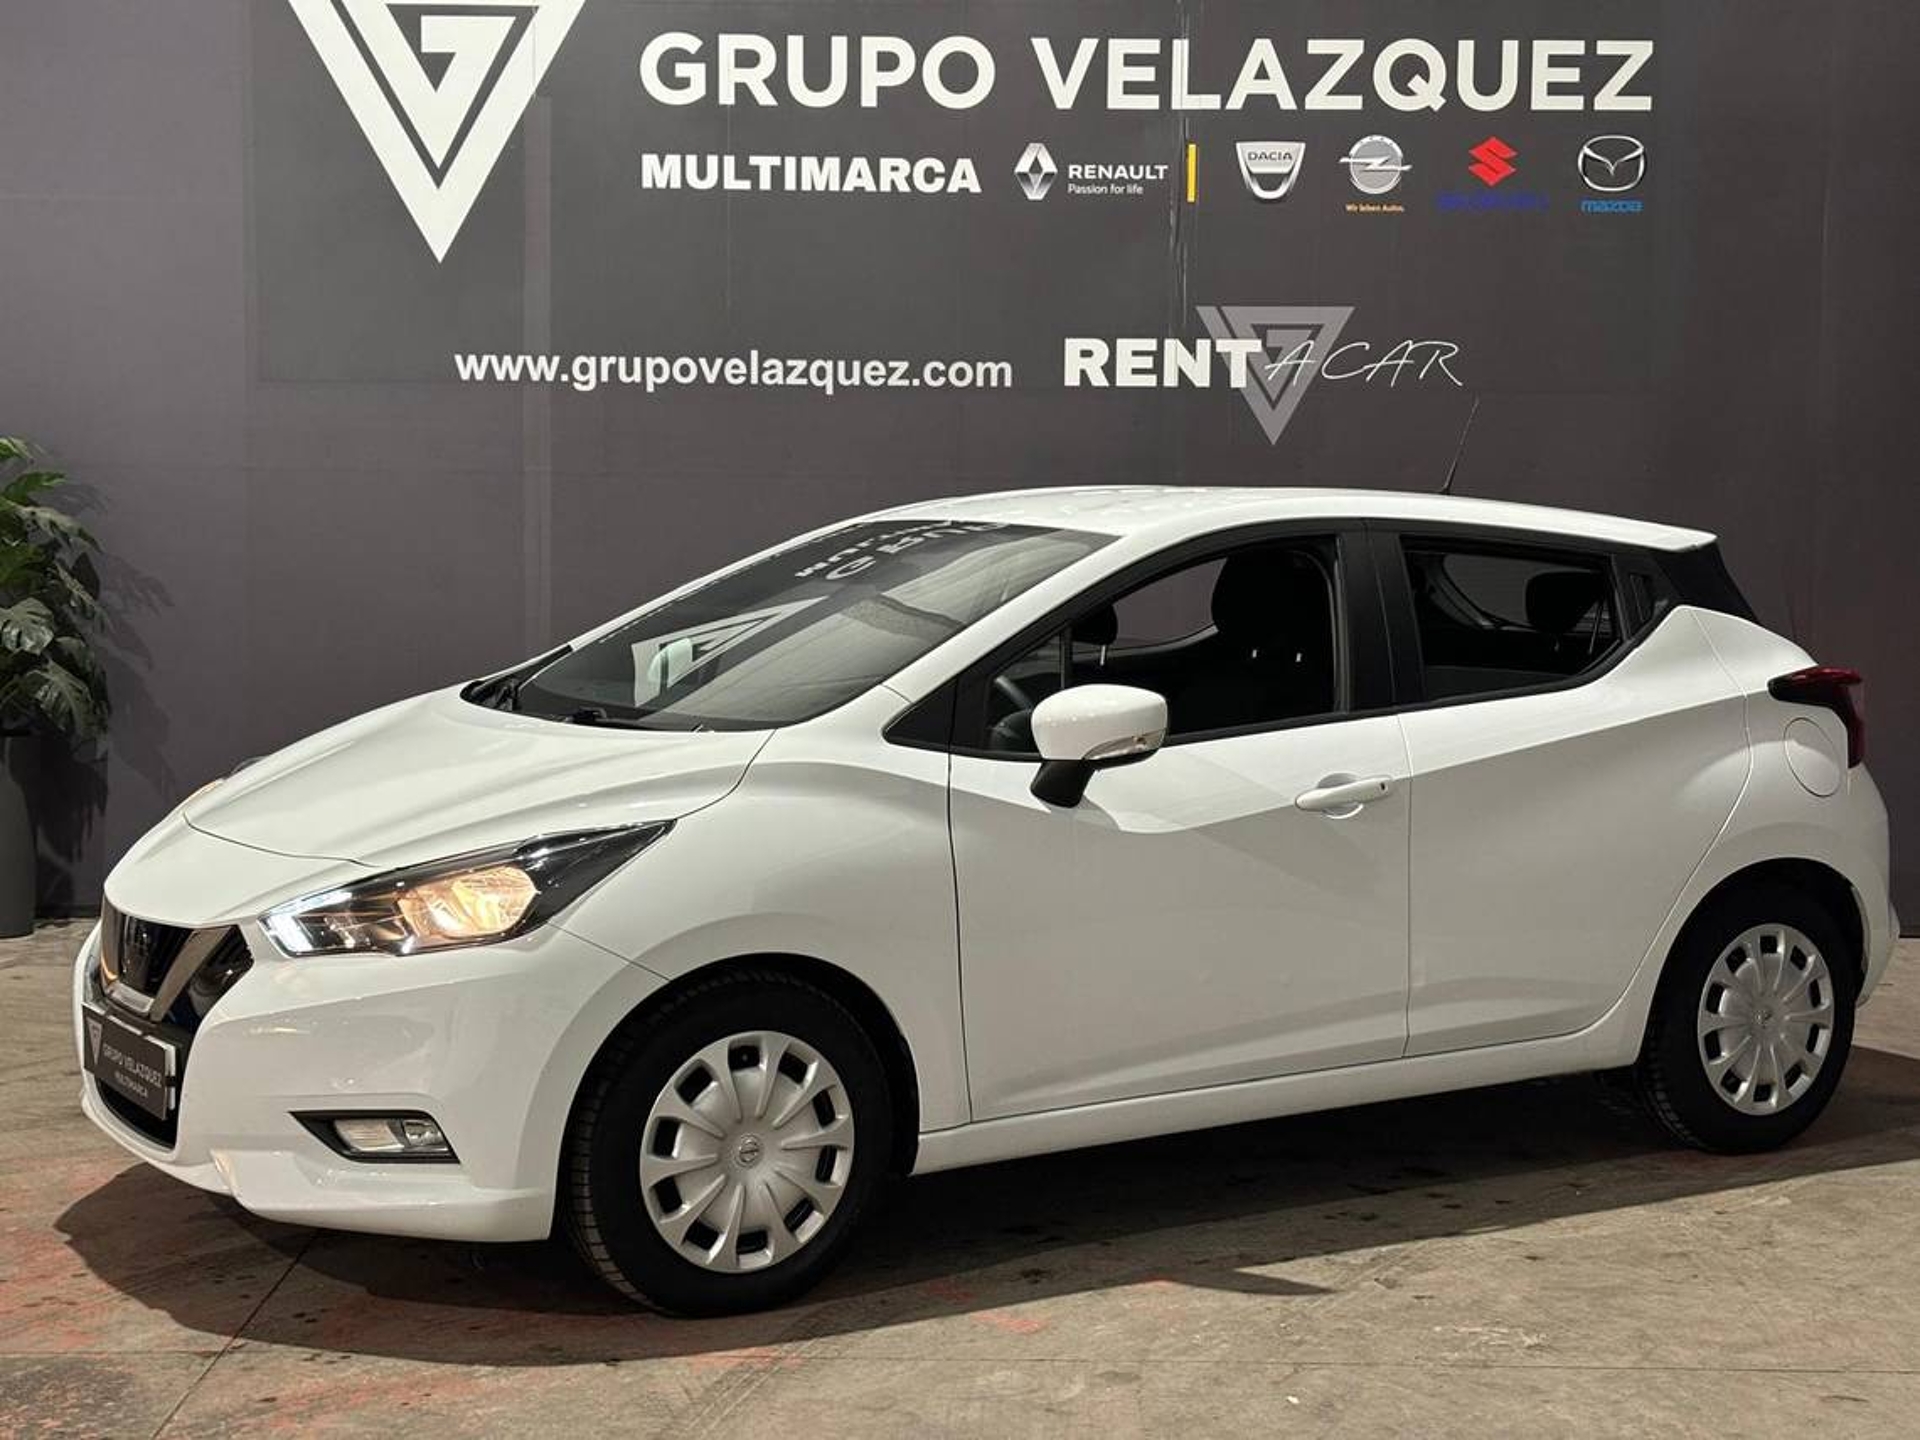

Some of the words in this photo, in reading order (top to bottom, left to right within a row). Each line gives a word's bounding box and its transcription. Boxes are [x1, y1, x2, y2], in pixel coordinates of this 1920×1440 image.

[640, 32, 996, 109] GRUPO
[1030, 38, 1654, 112] VELAZQUEZ
[641, 153, 982, 194] MULTIMARCA
[1068, 164, 1168, 180] RENAULT
[1247, 151, 1293, 161] DACIA
[1067, 183, 1109, 195] Passion
[1109, 183, 1126, 195] for
[1126, 183, 1144, 195] life
[455, 350, 1012, 396] www.grupovelazquez.com
[1064, 338, 1262, 389] RENT
[1264, 340, 1317, 386] A
[1322, 339, 1463, 387] CAR
